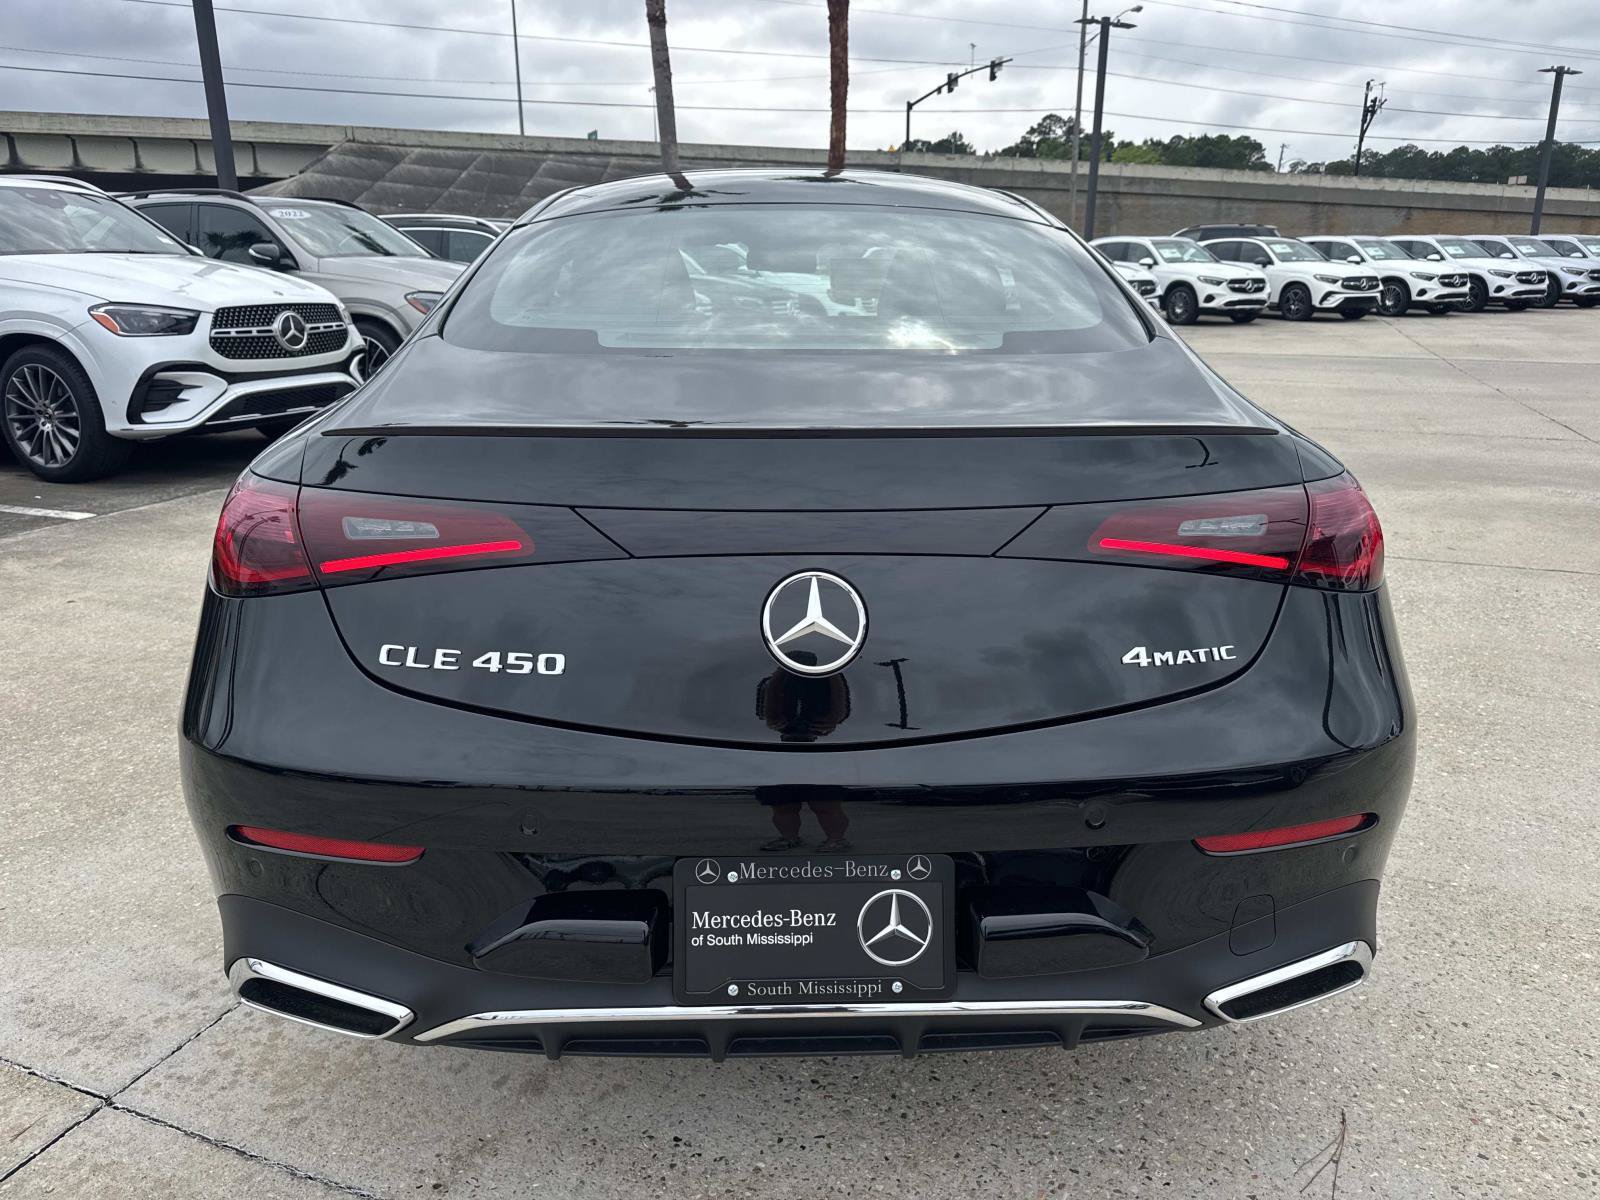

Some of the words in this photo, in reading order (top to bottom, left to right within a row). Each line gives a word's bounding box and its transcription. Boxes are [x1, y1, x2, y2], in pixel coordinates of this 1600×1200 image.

[378, 643, 462, 671] CLE
[472, 651, 566, 676] 450
[1121, 645, 1237, 667] 4MATIC
[739, 860, 889, 880] Mercedes-Benz
[691, 909, 837, 929] Mercedes-Benz
[691, 934, 704, 946] of
[706, 933, 743, 946] South
[746, 932, 814, 947] Mississippi
[747, 981, 793, 997] South
[798, 979, 883, 998] Mississippi
